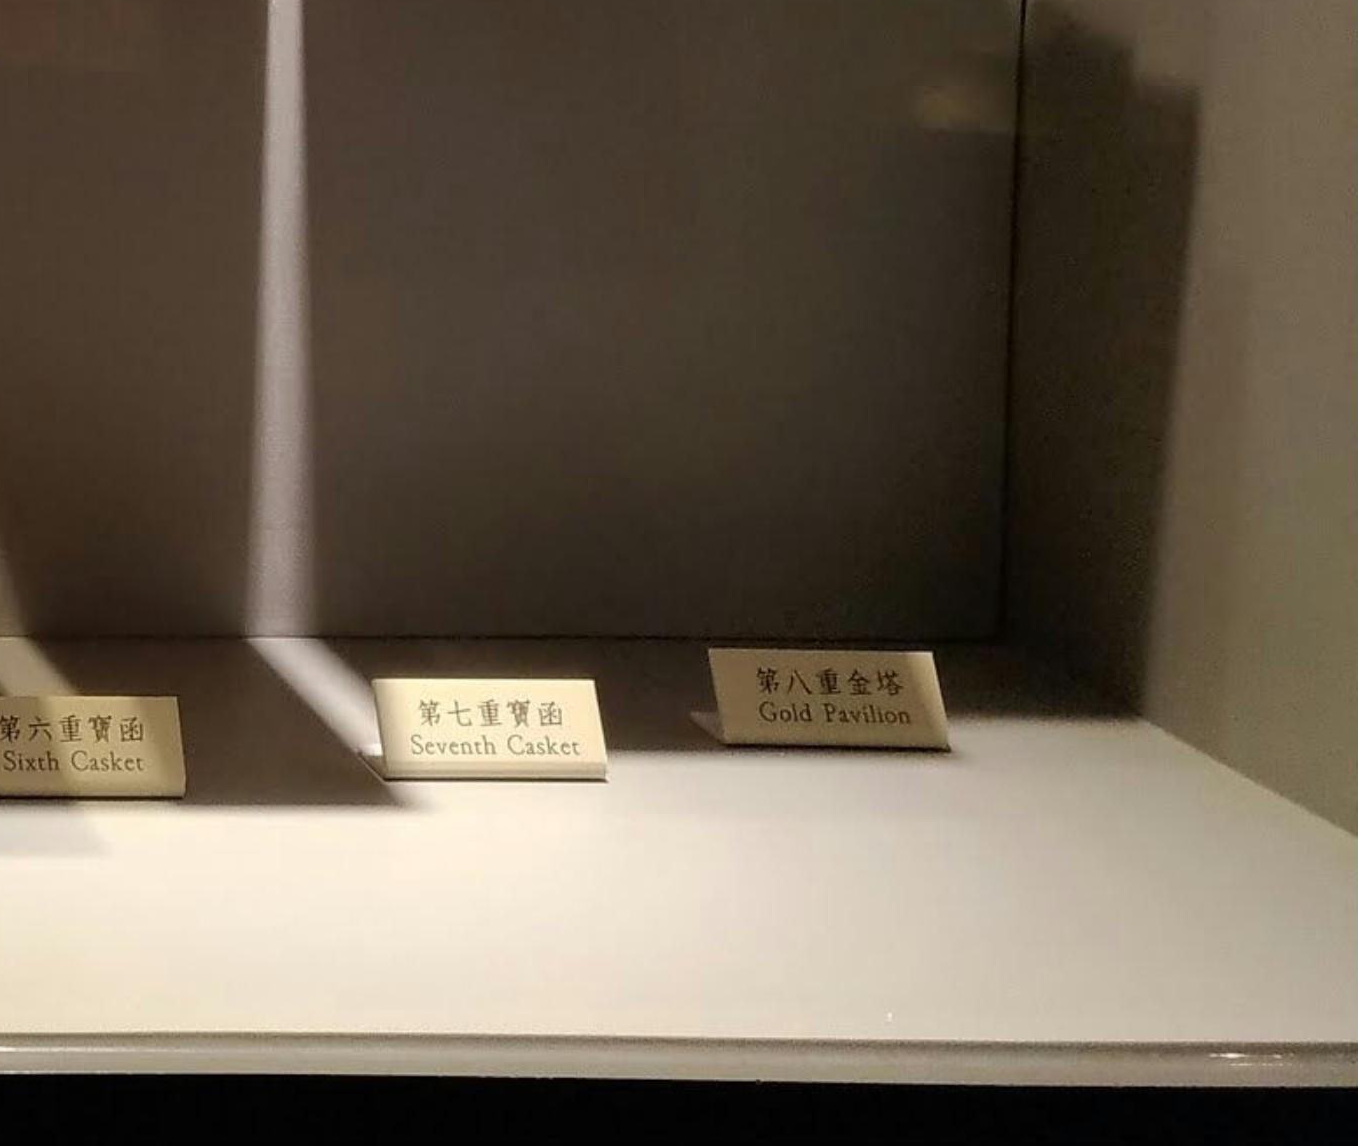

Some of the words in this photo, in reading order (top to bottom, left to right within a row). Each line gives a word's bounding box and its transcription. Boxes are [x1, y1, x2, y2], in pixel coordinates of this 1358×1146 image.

[756, 666, 904, 697] 第八重金塔
[418, 698, 563, 729] 第七重寶函
[759, 700, 813, 724] Gold
[823, 700, 912, 725] Pavilion
[410, 734, 497, 756] Seventh
[506, 734, 581, 756] Casket
[2, 750, 60, 772] Sixth
[70, 750, 145, 772] Casket
